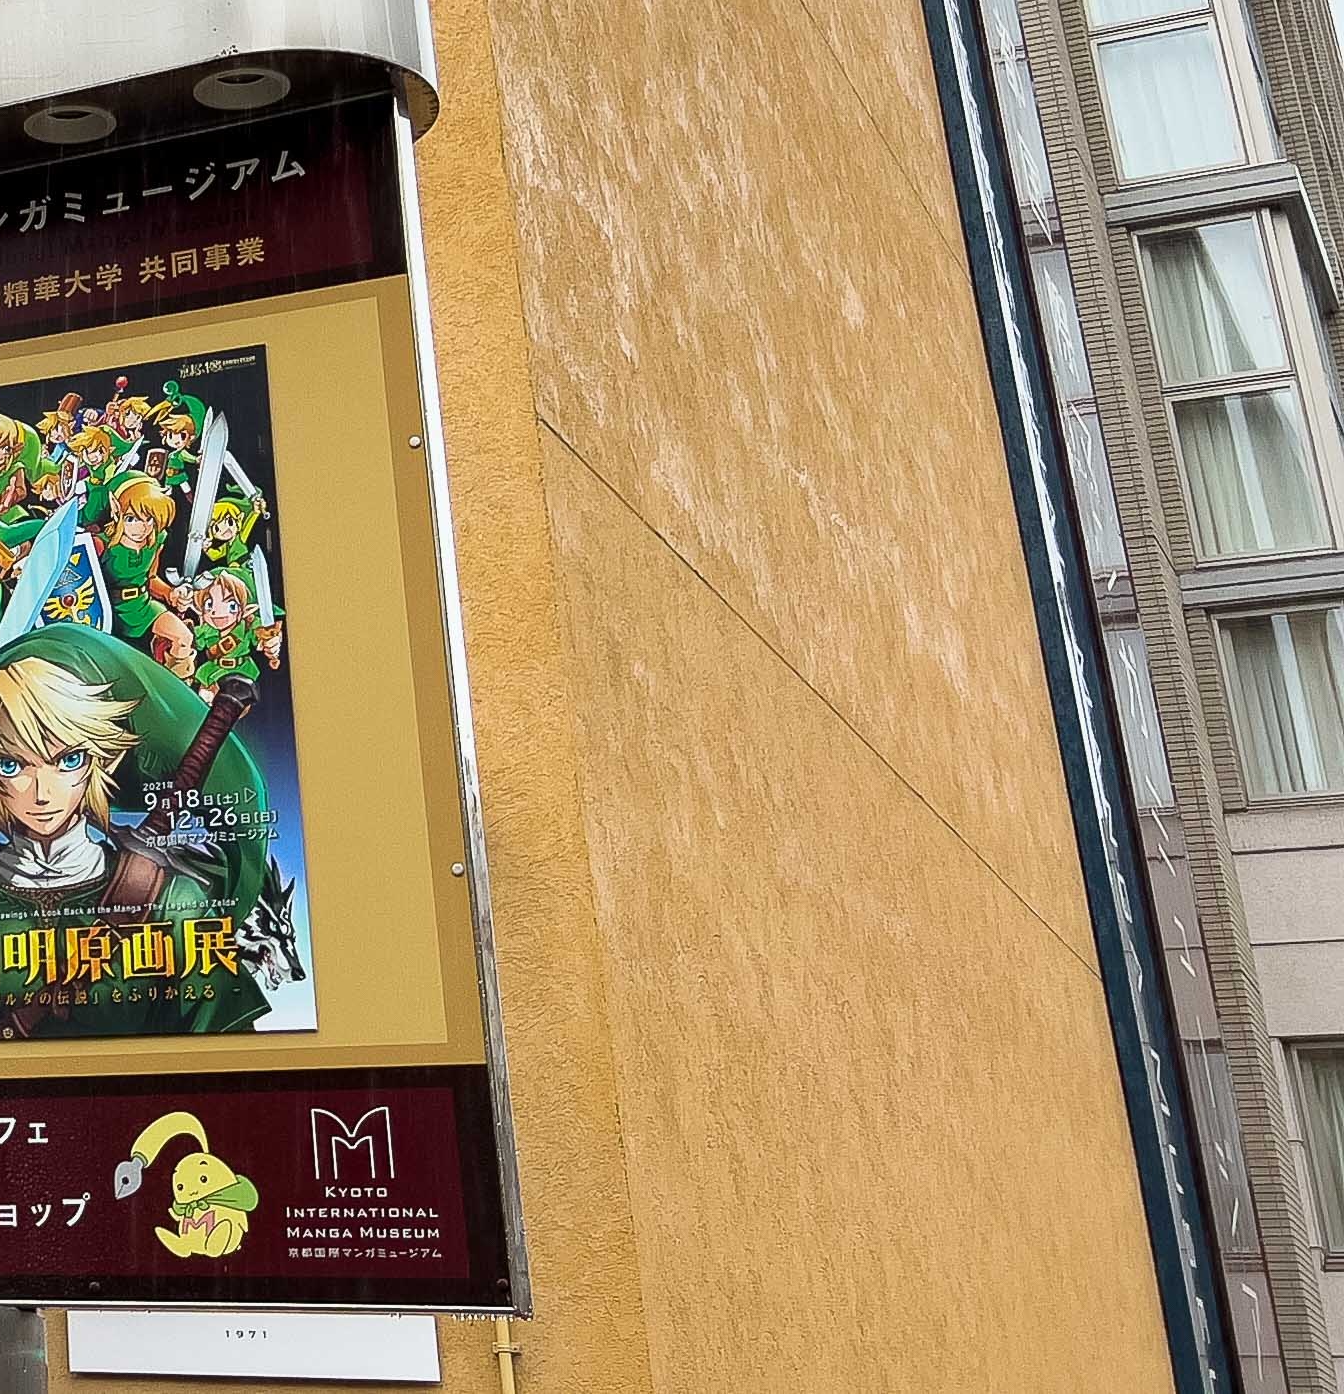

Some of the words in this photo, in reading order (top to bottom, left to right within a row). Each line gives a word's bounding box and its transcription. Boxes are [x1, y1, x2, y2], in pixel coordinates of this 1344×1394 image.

[138, 235, 266, 284] 共同事業
[142, 781, 174, 792] 2021年
[41, 908, 62, 918] Look
[63, 907, 85, 917] Back
[97, 905, 111, 915] the
[113, 904, 142, 915] Manga
[325, 1185, 388, 1199] KYOTO
[286, 1206, 440, 1219] INTERNATIONAL
[286, 1226, 353, 1239] MANGA
[360, 1226, 441, 1239] MUSEUM
[287, 1246, 443, 1259] 京都国際マンガミュージアム
[224, 1329, 269, 1341] 1971
